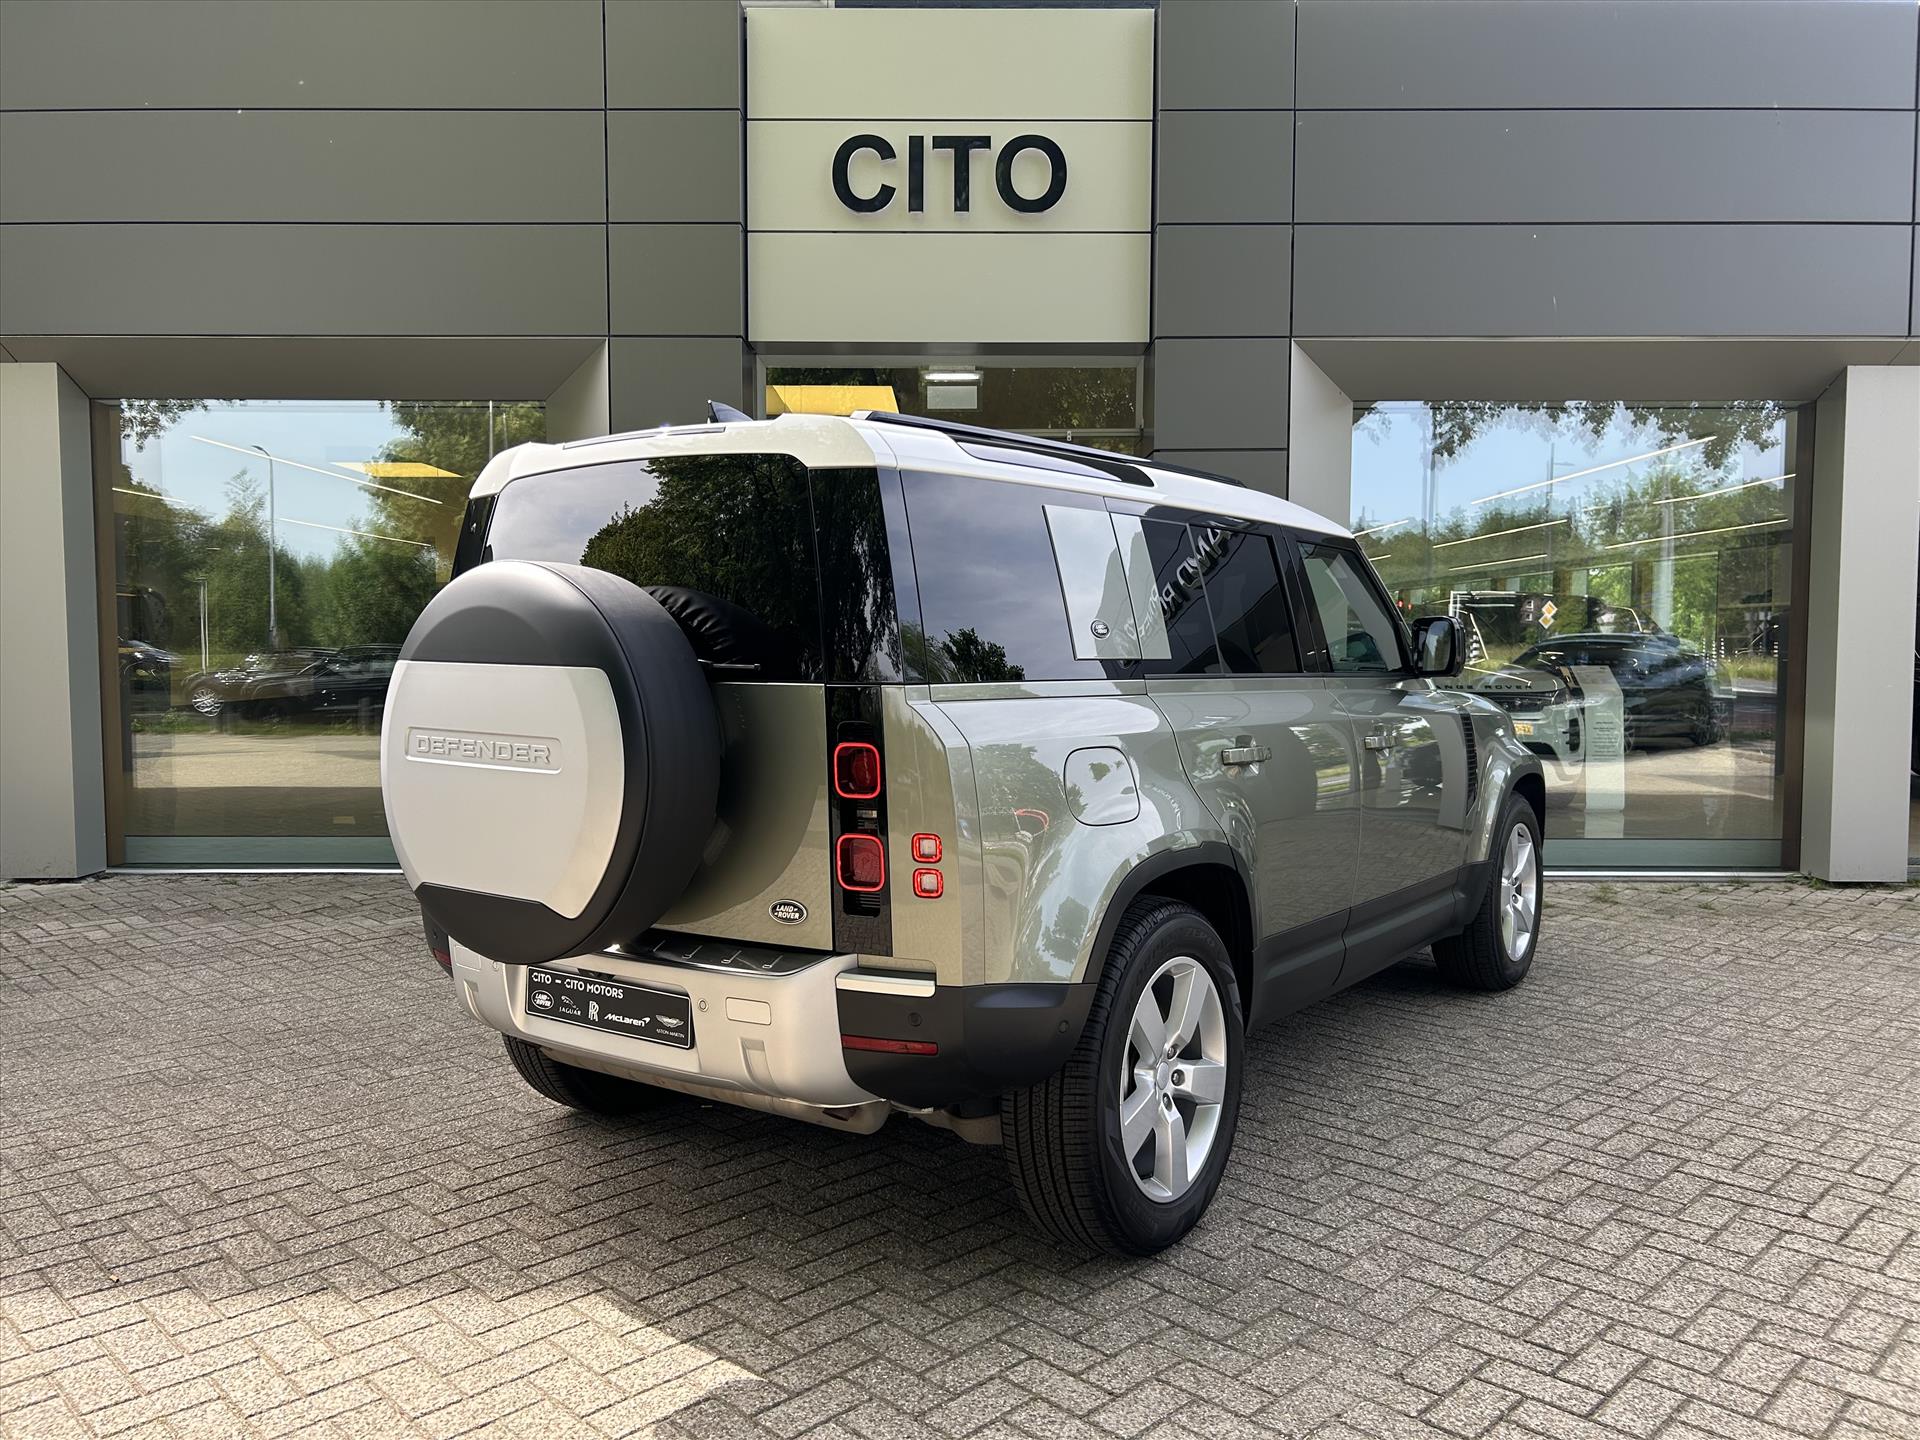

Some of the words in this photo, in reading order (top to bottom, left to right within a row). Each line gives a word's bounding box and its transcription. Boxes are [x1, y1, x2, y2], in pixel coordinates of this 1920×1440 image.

[832, 134, 1068, 214] CITO
[415, 734, 551, 764] DEFENDER
[531, 972, 552, 985] CITO
[564, 978, 585, 991] CITO
[586, 983, 624, 999] MOTORS
[559, 1006, 581, 1016] JAGUAR
[604, 1012, 646, 1028] McLaren
